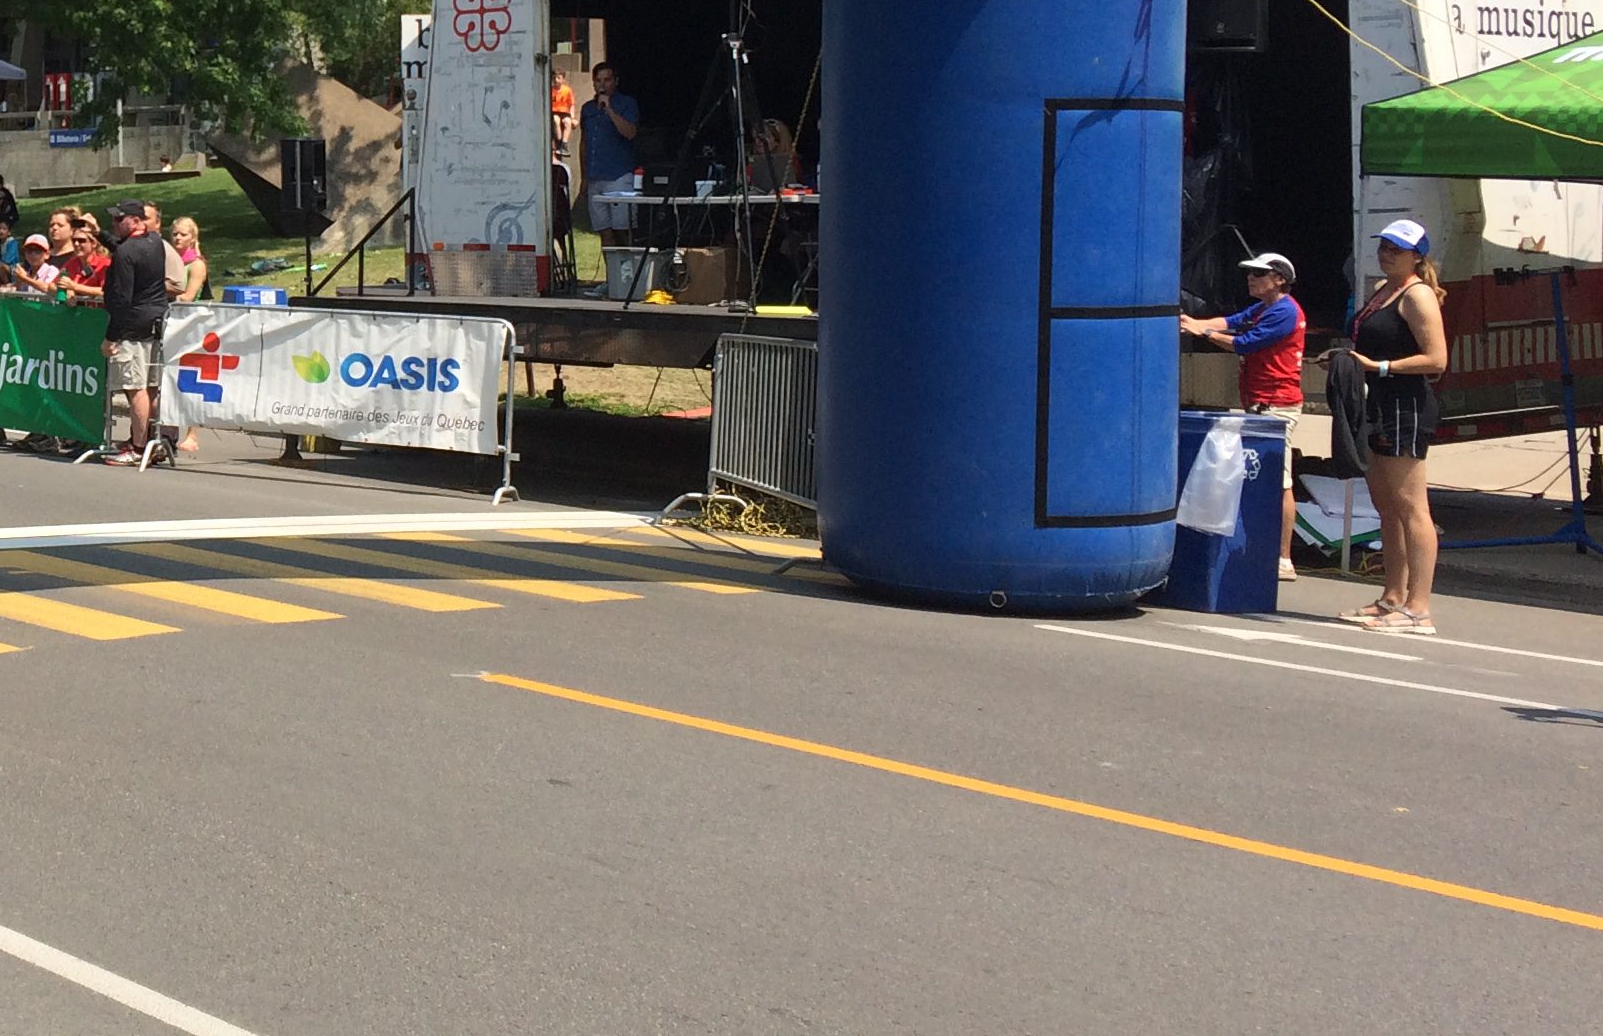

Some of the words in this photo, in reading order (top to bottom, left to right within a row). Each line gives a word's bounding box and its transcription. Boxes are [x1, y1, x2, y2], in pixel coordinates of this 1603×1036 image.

[340, 352, 461, 393] OASIS
[271, 400, 305, 417] Grand
[306, 406, 364, 422] partenaire
[367, 409, 390, 424] des
[392, 410, 419, 426] Jeux
